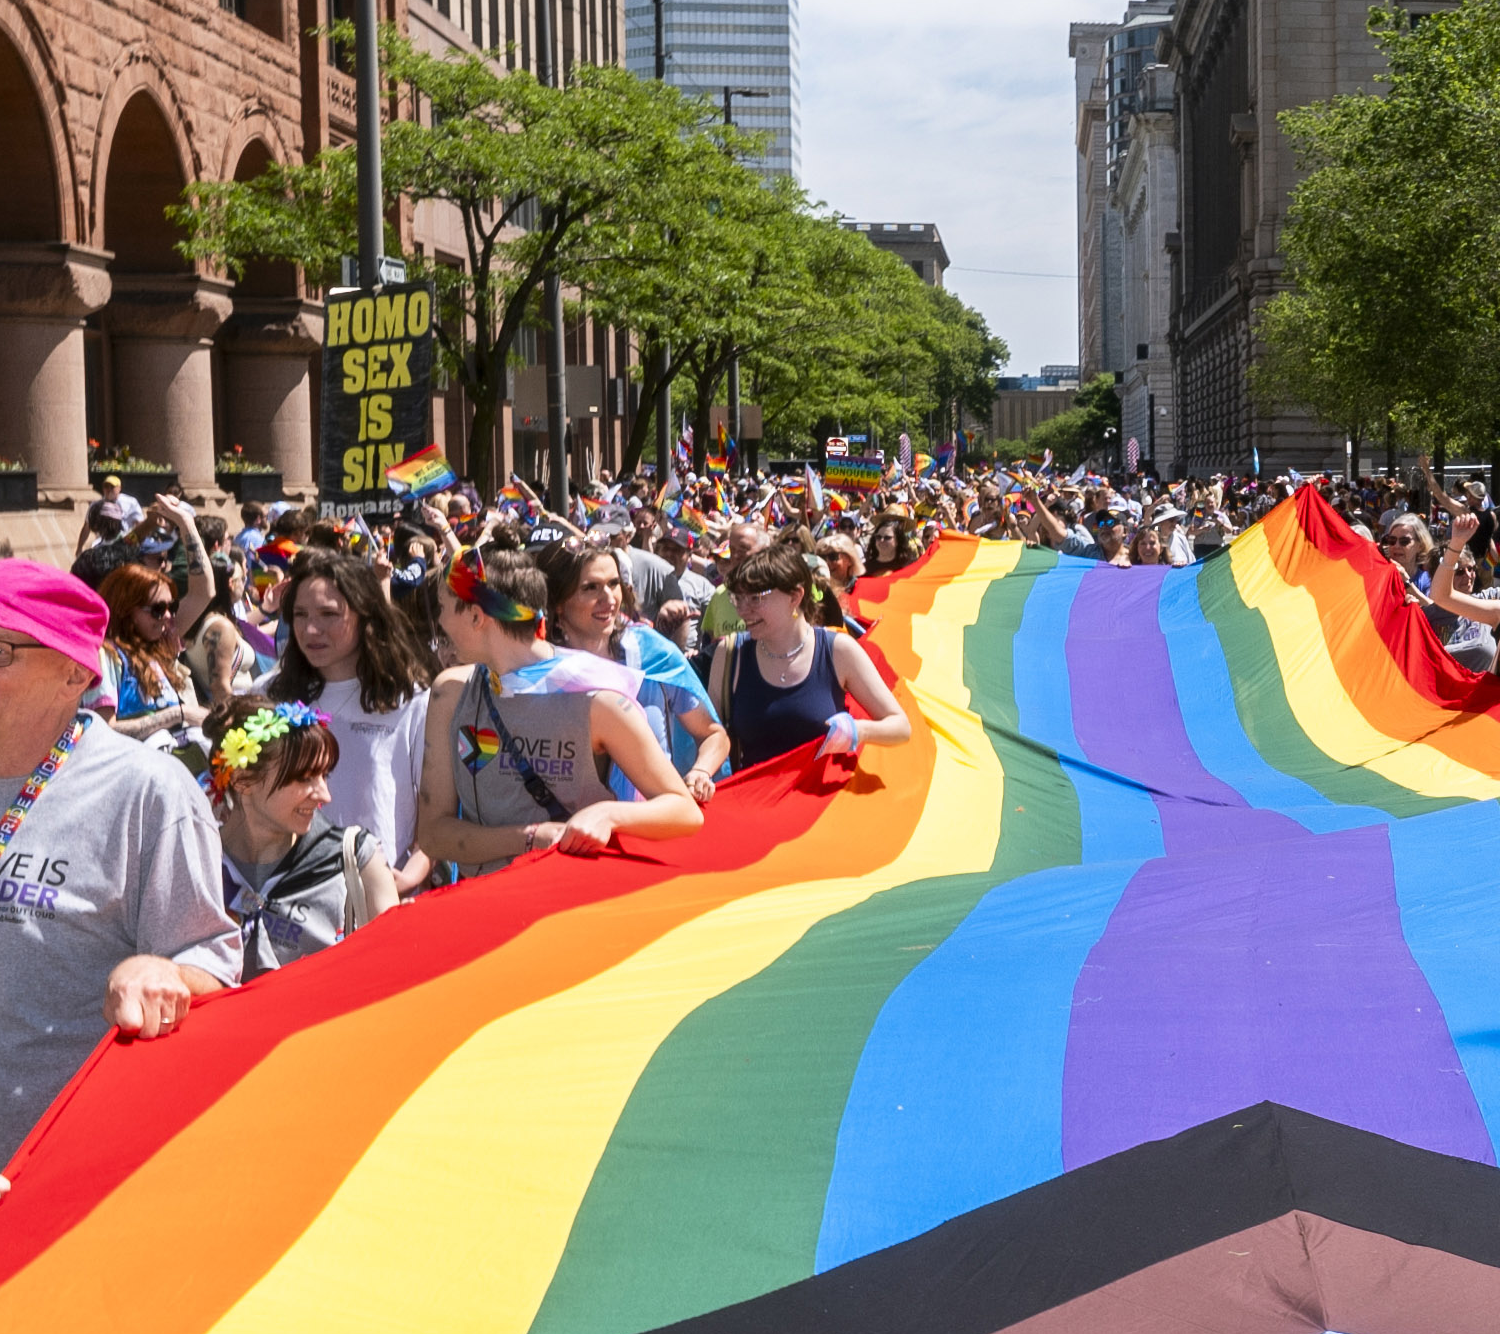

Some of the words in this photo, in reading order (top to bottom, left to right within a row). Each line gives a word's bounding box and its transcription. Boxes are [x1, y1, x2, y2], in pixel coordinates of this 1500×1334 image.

[327, 290, 431, 347] HOMO
[342, 342, 413, 395] SEX
[358, 394, 393, 442] IS
[342, 442, 406, 493] SIN
[320, 498, 404, 518] Romans
[531, 528, 563, 542] REV
[557, 740, 576, 759] IS
[25, 752, 62, 796] PRIDE
[38, 857, 69, 886] IS
[287, 900, 310, 923] IS
